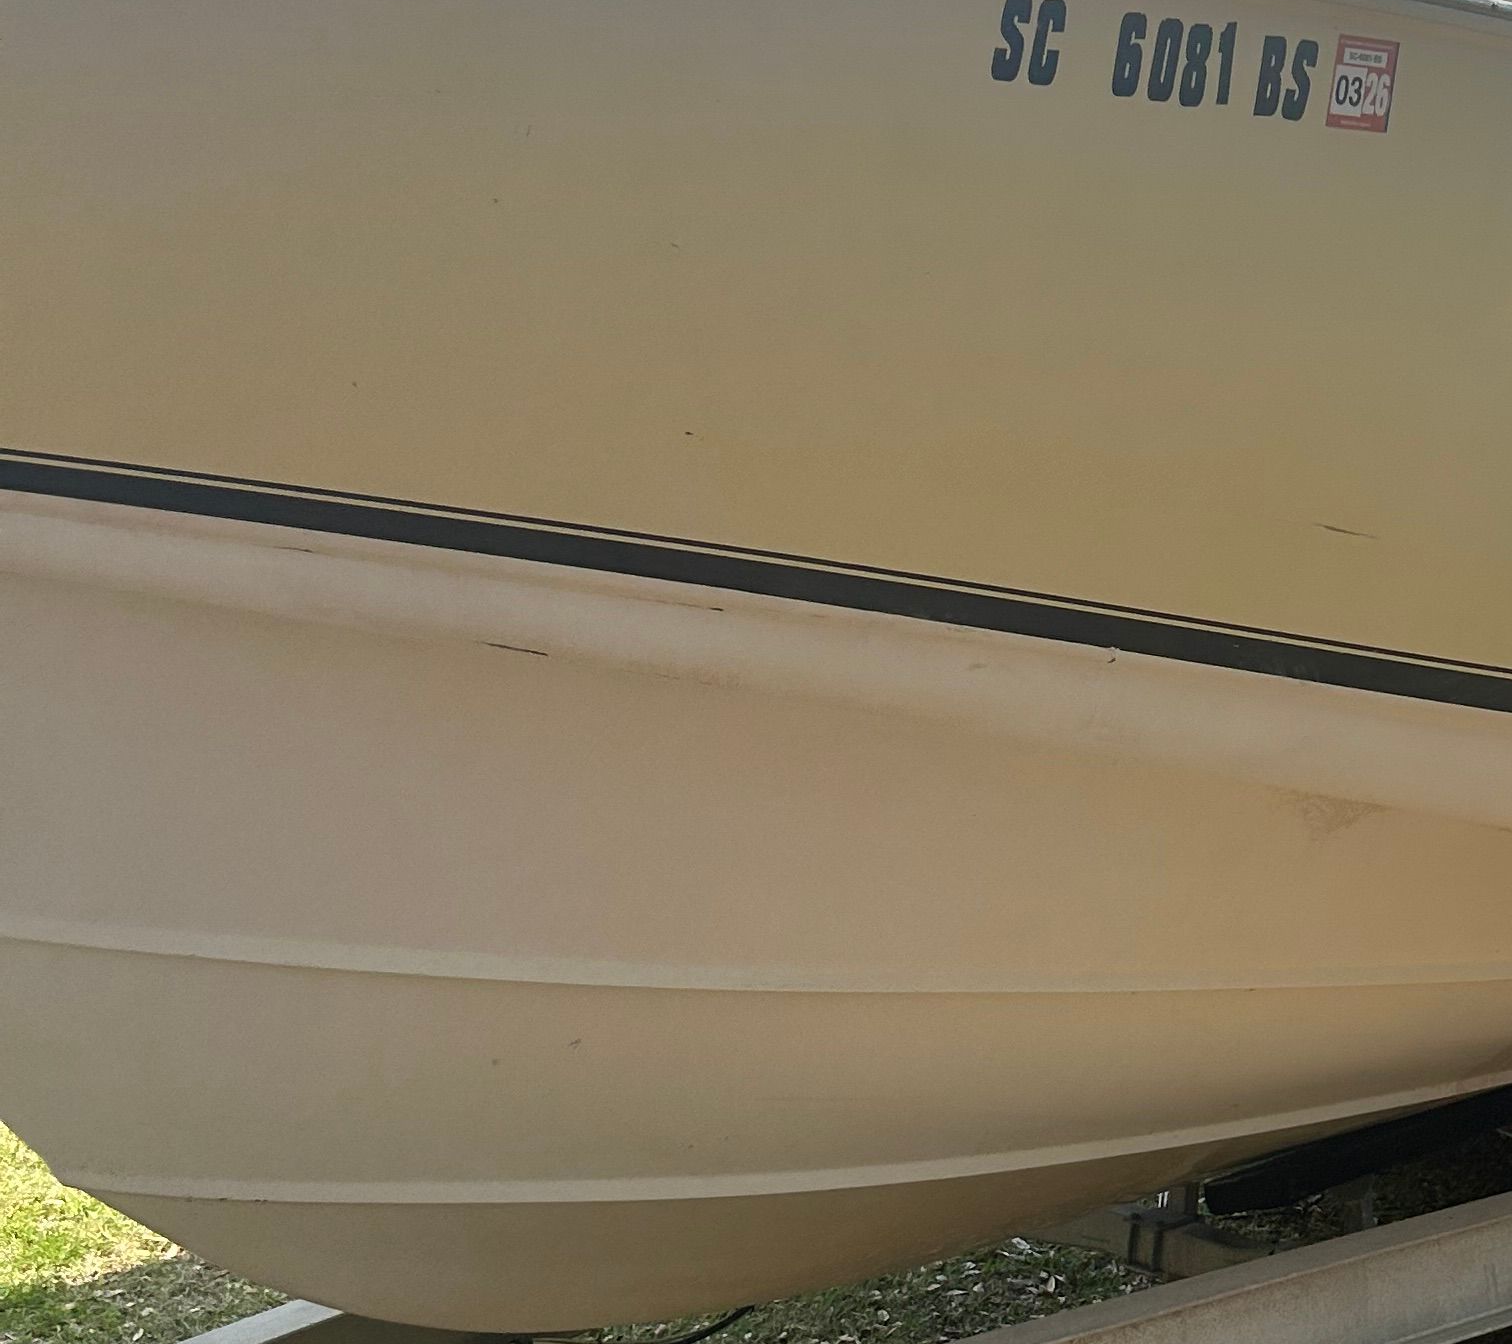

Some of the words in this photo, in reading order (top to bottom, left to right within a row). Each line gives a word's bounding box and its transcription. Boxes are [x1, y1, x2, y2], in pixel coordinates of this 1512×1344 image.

[1112, 11, 1238, 107] 6081
[1253, 35, 1319, 121] BS
[1335, 74, 1363, 107] 03
[1362, 72, 1391, 117] 26
